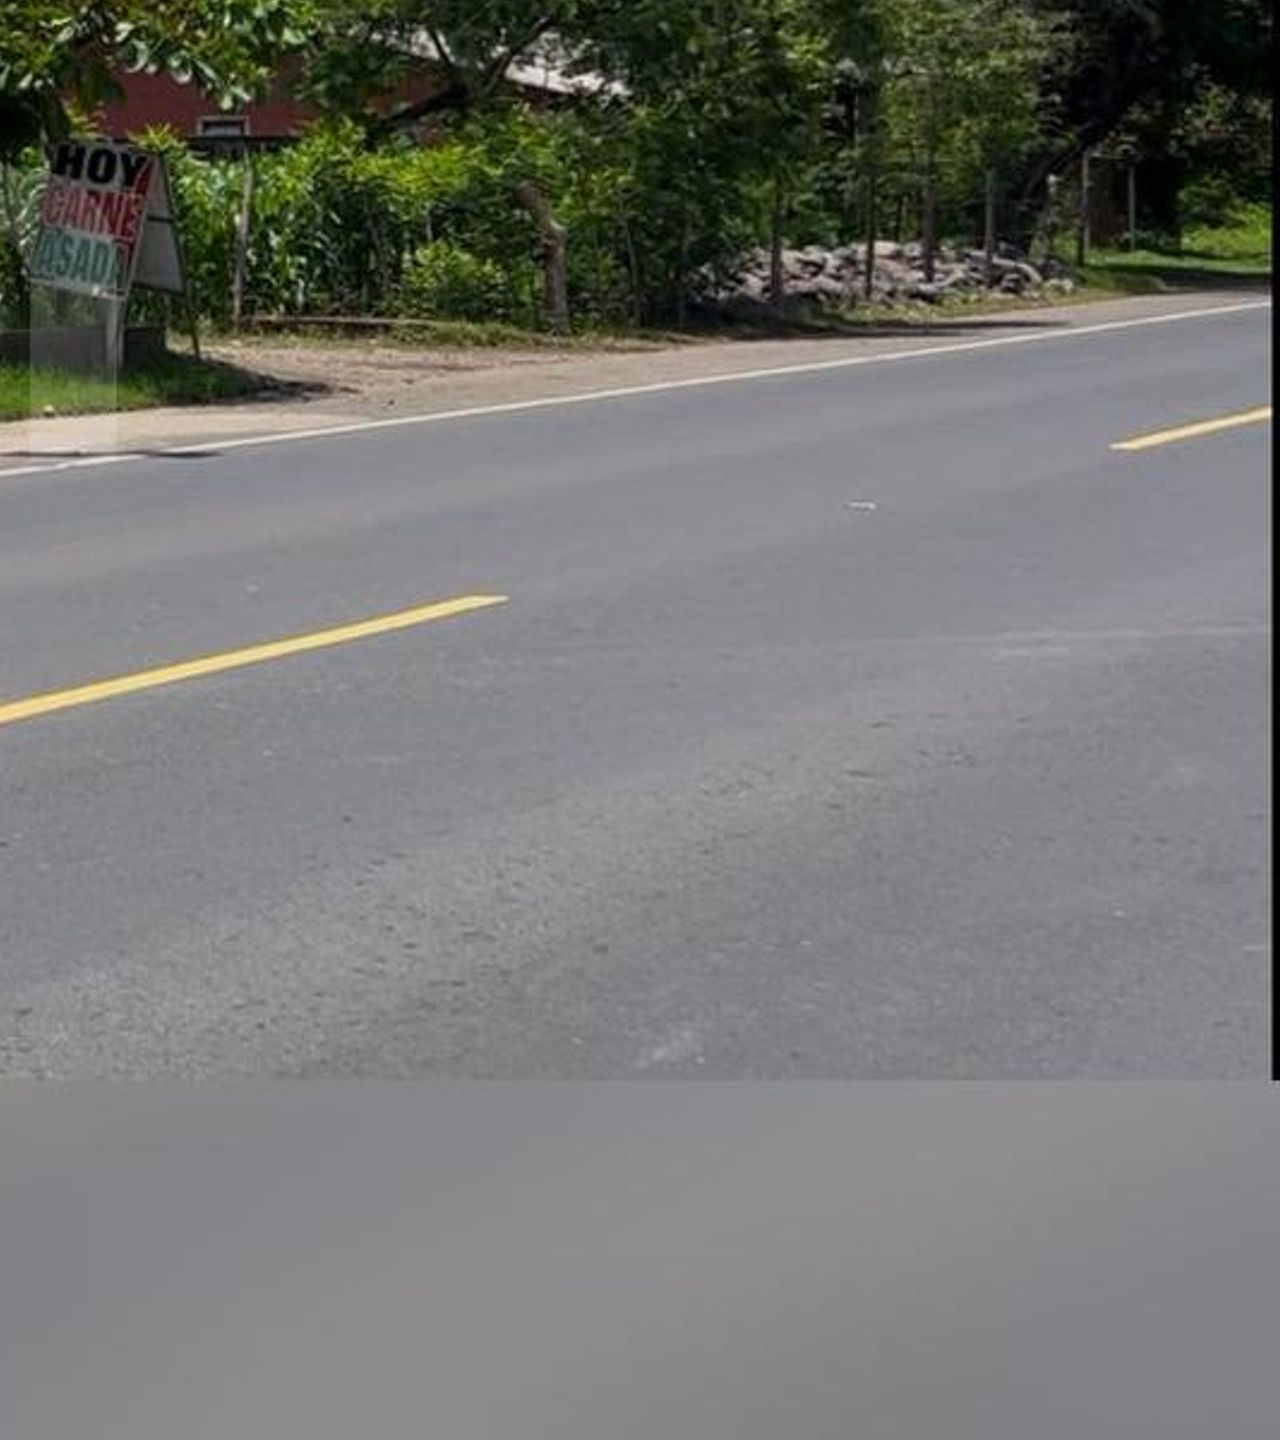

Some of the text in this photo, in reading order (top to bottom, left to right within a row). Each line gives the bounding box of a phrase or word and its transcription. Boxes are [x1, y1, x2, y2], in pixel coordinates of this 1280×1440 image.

[53, 142, 150, 187] HOY
[42, 180, 143, 240] CARNE
[34, 226, 130, 294] ASADA
